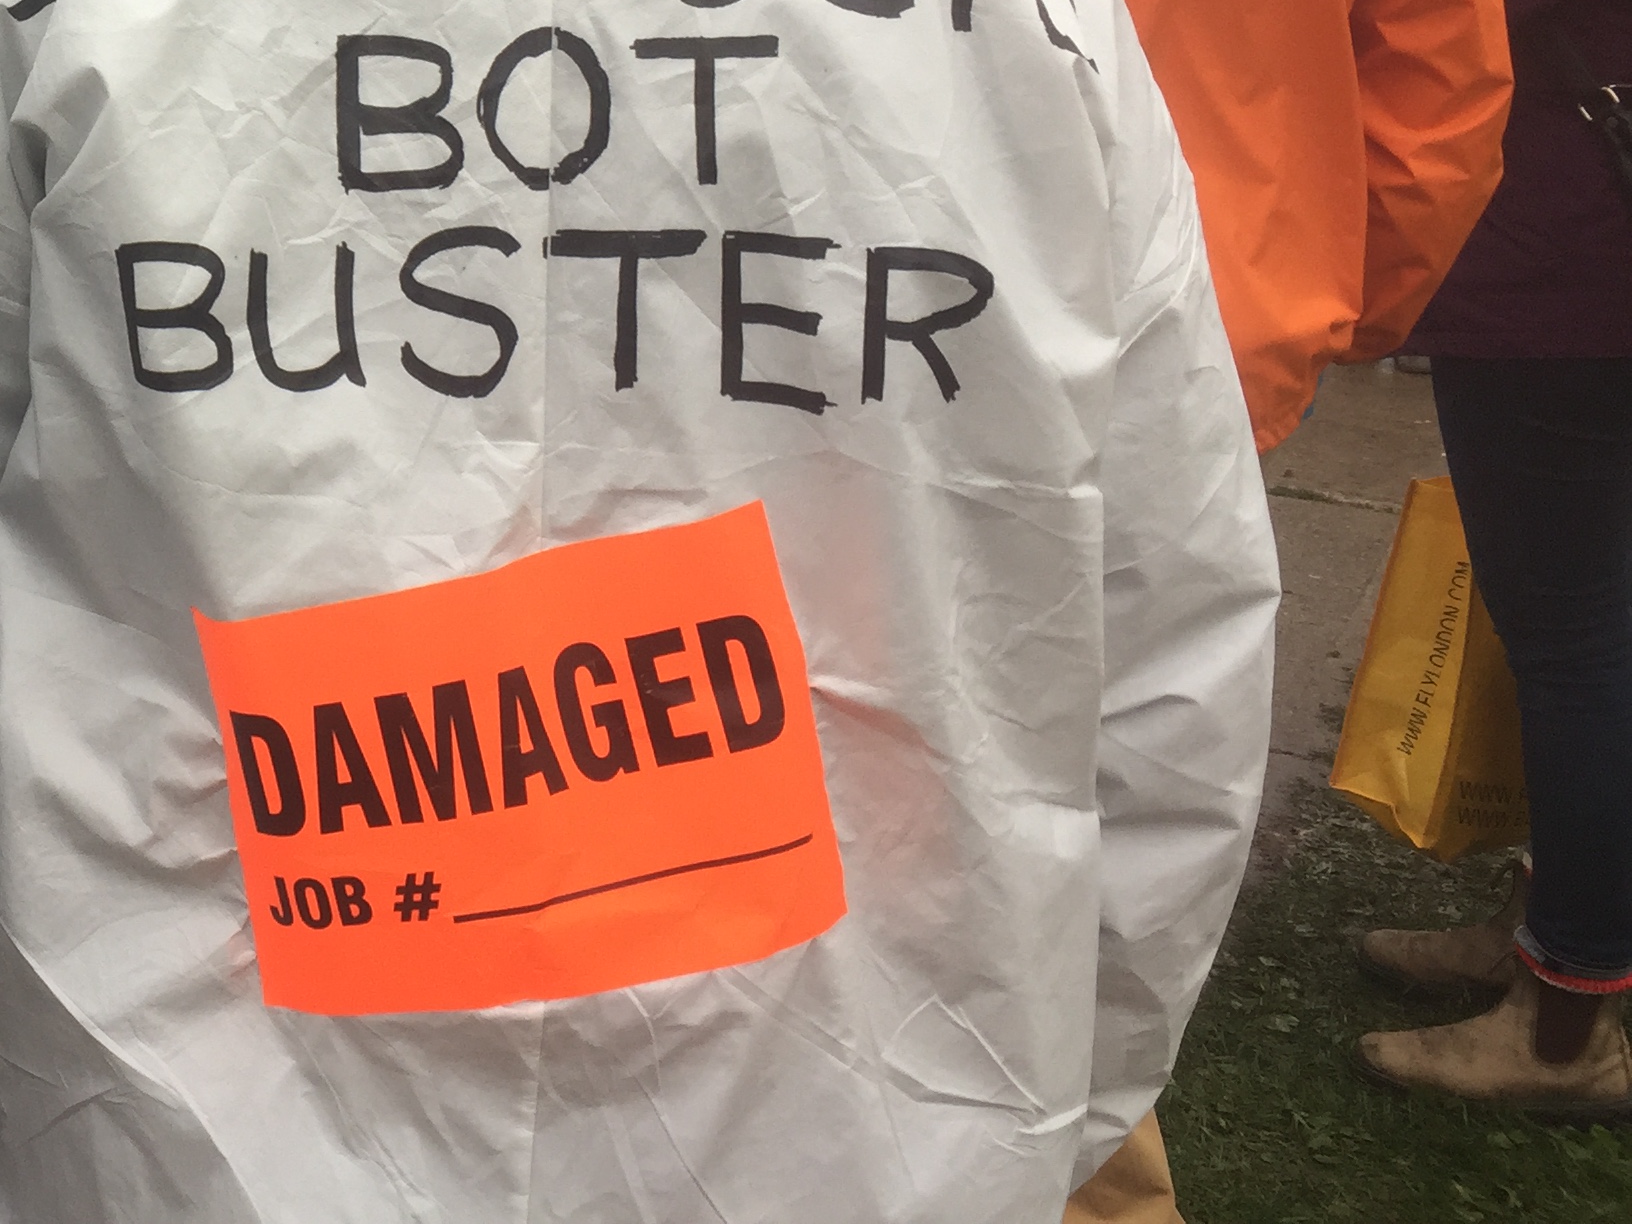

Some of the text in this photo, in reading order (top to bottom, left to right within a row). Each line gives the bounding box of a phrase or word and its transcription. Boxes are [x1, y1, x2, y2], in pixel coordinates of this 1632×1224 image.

[334, 26, 779, 194] BOT
[115, 225, 995, 416] BUSTER
[229, 614, 786, 838] DAMAGED
[269, 871, 442, 931] JOB #
